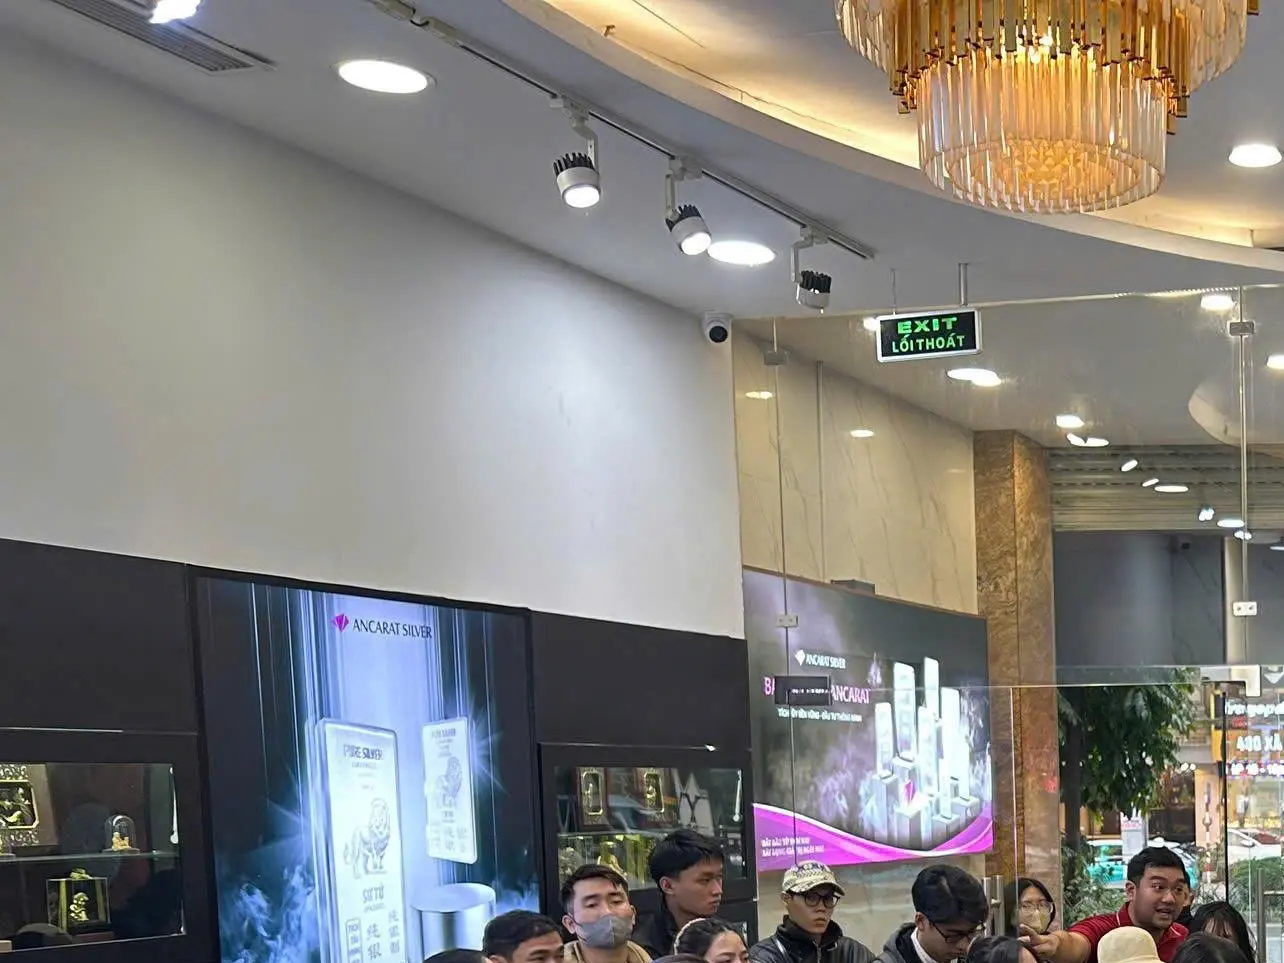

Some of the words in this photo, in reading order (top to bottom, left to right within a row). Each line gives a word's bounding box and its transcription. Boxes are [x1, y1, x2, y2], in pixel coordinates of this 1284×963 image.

[897, 317, 958, 334] EXIT
[916, 332, 965, 351] THOÁT
[352, 618, 400, 636] ANCARAT
[402, 623, 433, 639] SILVER
[831, 684, 871, 704] ANCARAT
